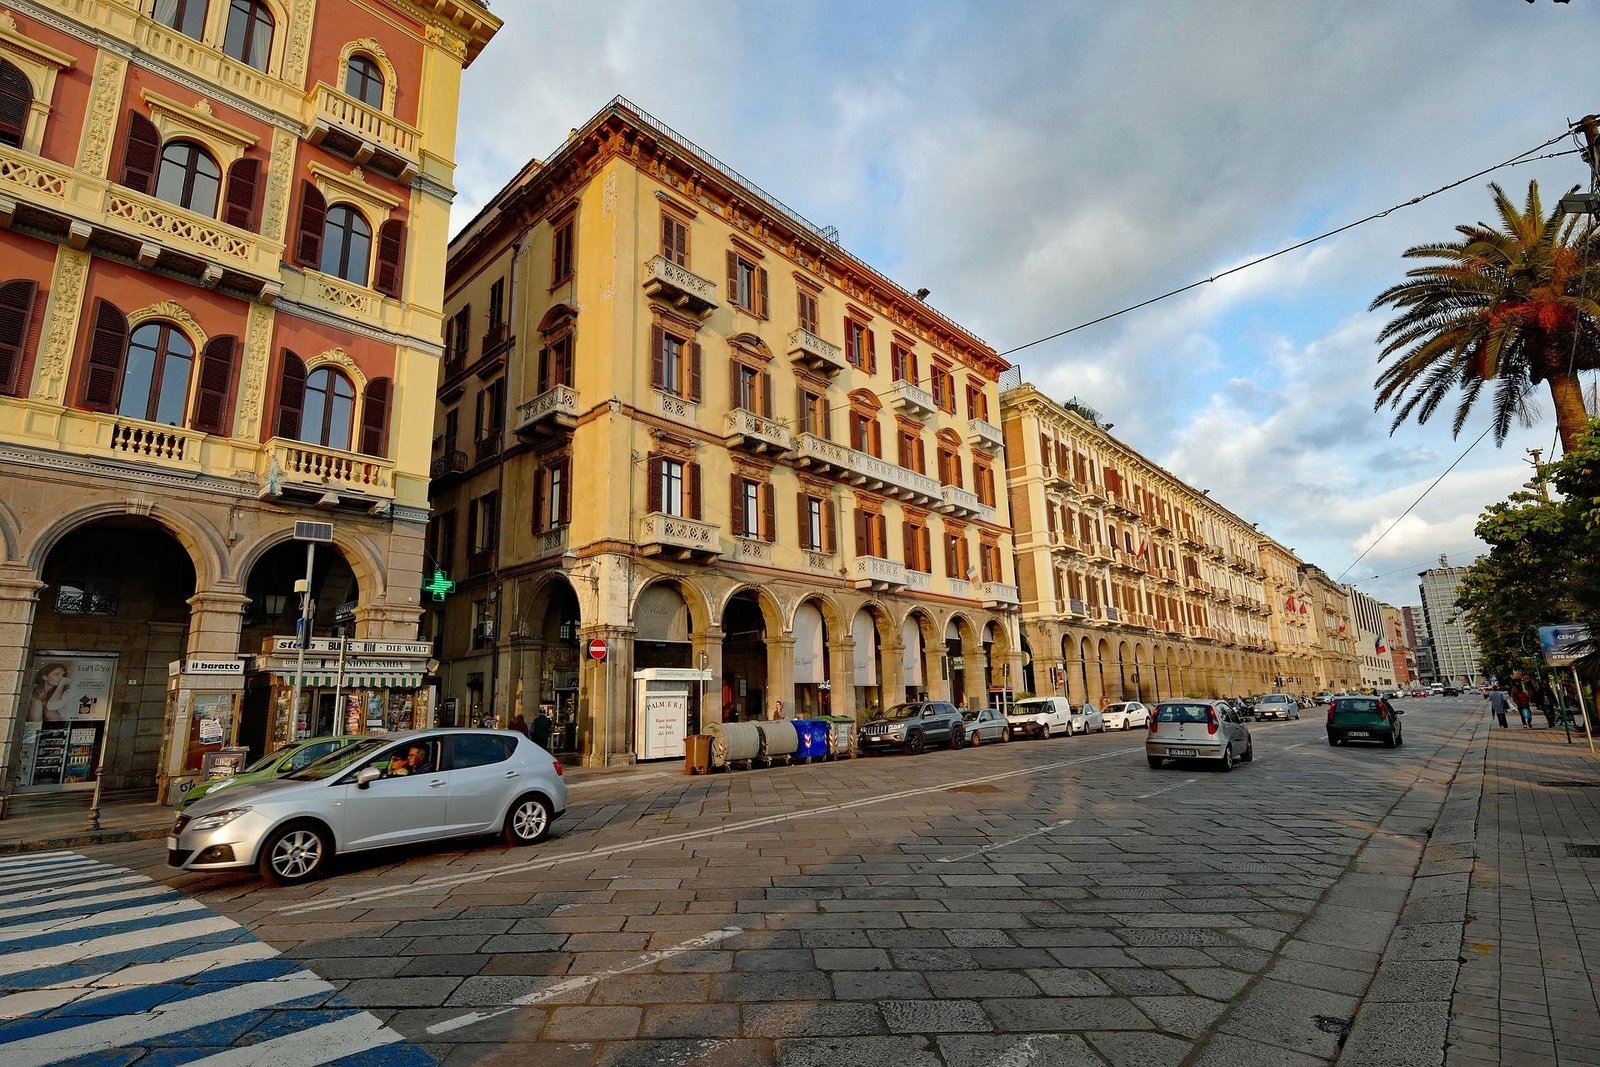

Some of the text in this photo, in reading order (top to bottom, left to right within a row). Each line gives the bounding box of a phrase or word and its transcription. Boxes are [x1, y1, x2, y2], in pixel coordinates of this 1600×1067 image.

[279, 640, 316, 649] sten
[328, 641, 353, 651] BUE
[405, 645, 428, 653] WELT
[200, 662, 240, 670] baratto
[333, 659, 404, 669] L'NIONE SARDA
